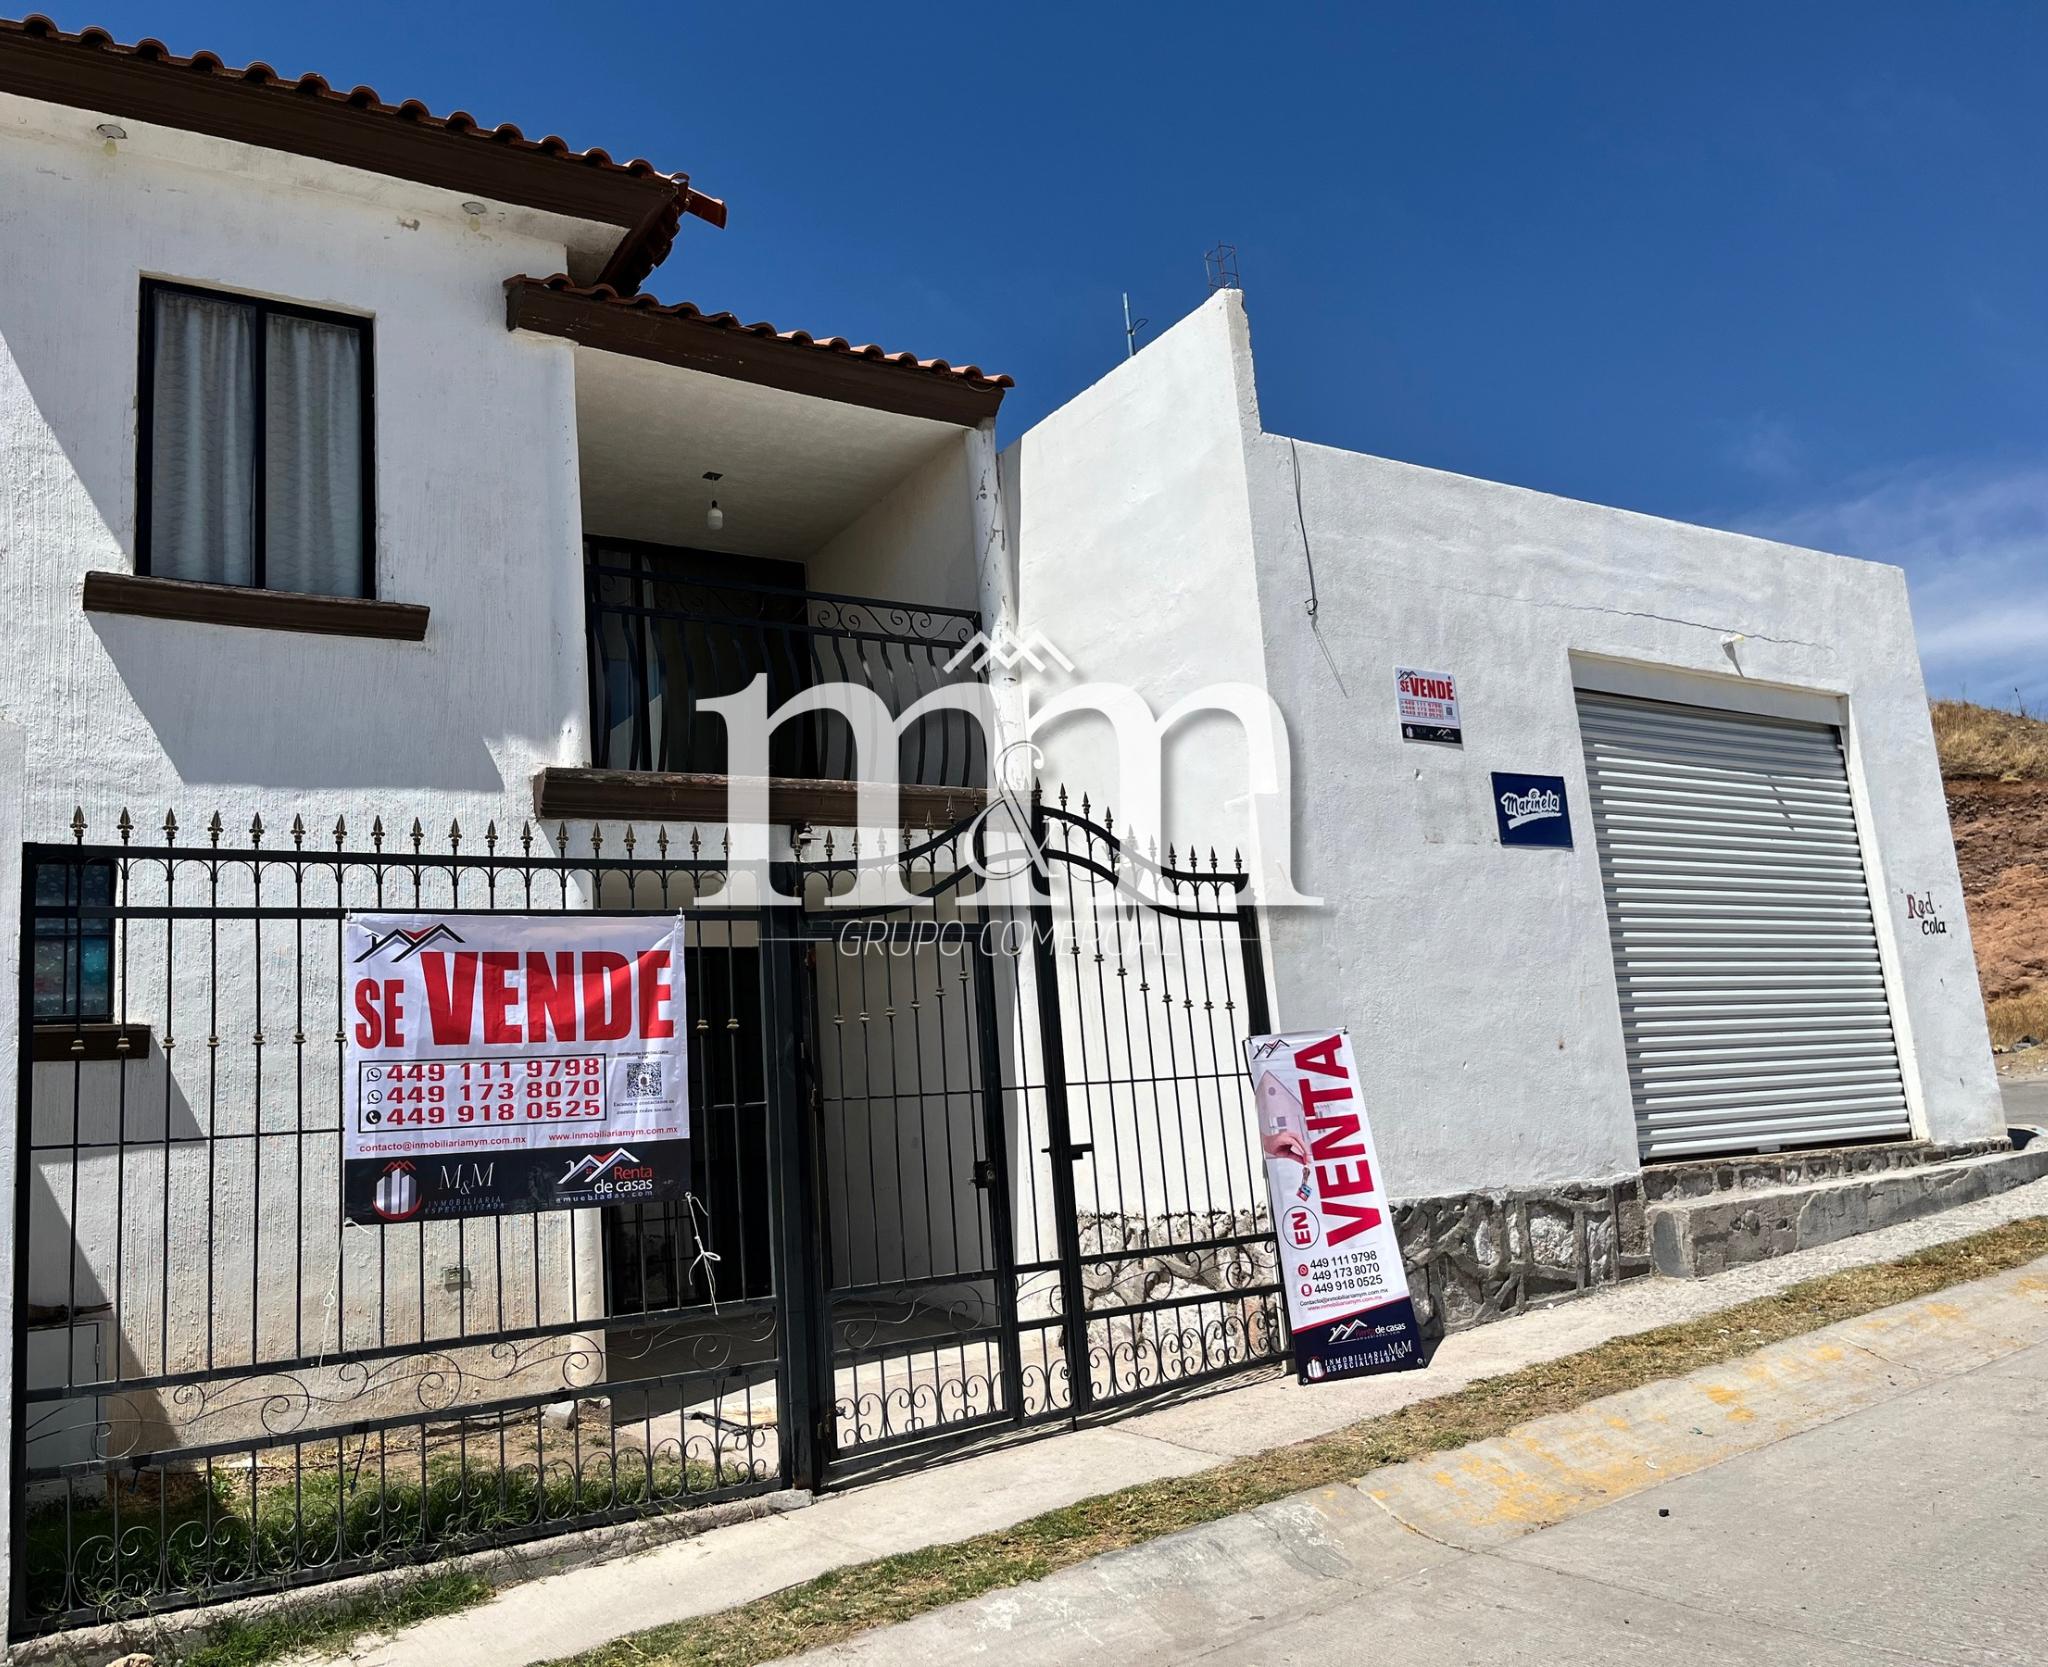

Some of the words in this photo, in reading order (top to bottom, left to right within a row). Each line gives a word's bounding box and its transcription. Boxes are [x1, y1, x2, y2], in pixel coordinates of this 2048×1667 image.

[1400, 680, 1410, 692] SE
[1409, 677, 1454, 700] VENDE
[1501, 788, 1560, 817] Marinela
[1906, 891, 1935, 919] Red
[355, 978, 405, 1049] SE
[420, 950, 675, 1046] VENDE
[387, 1063, 446, 1082] 449
[460, 1061, 511, 1080] 111
[526, 1058, 600, 1077] 9798
[387, 1085, 446, 1104] 449
[460, 1083, 514, 1101] 173
[526, 1079, 600, 1098] 8070
[387, 1106, 446, 1125] 449
[458, 1103, 515, 1122] 918
[526, 1100, 600, 1119] 0525
[548, 1126, 678, 1142] www.inmobiliariamym.com.mx
[1294, 1034, 1382, 1247] VENTA
[359, 1136, 527, 1153] contacto@inmobiliariamym.com.mx
[613, 1165, 653, 1181] Renta
[594, 1178, 613, 1194] de
[615, 1179, 653, 1193] casas
[1291, 1211, 1312, 1245] EN
[1310, 1257, 1329, 1269] 449
[1331, 1254, 1349, 1266] 111
[1351, 1250, 1377, 1263] 9798
[1312, 1270, 1332, 1281] 449
[1333, 1266, 1353, 1278] 173
[1354, 1262, 1380, 1275] 8070
[1314, 1282, 1334, 1294] 449
[1335, 1278, 1355, 1291] 918
[1356, 1274, 1383, 1287] 0525
[1375, 1324, 1386, 1335] de
[1386, 1322, 1406, 1333] casas
[1324, 1350, 1389, 1367] INMOBILIARIA
[1326, 1355, 1397, 1373] ESPECIALIZADA
